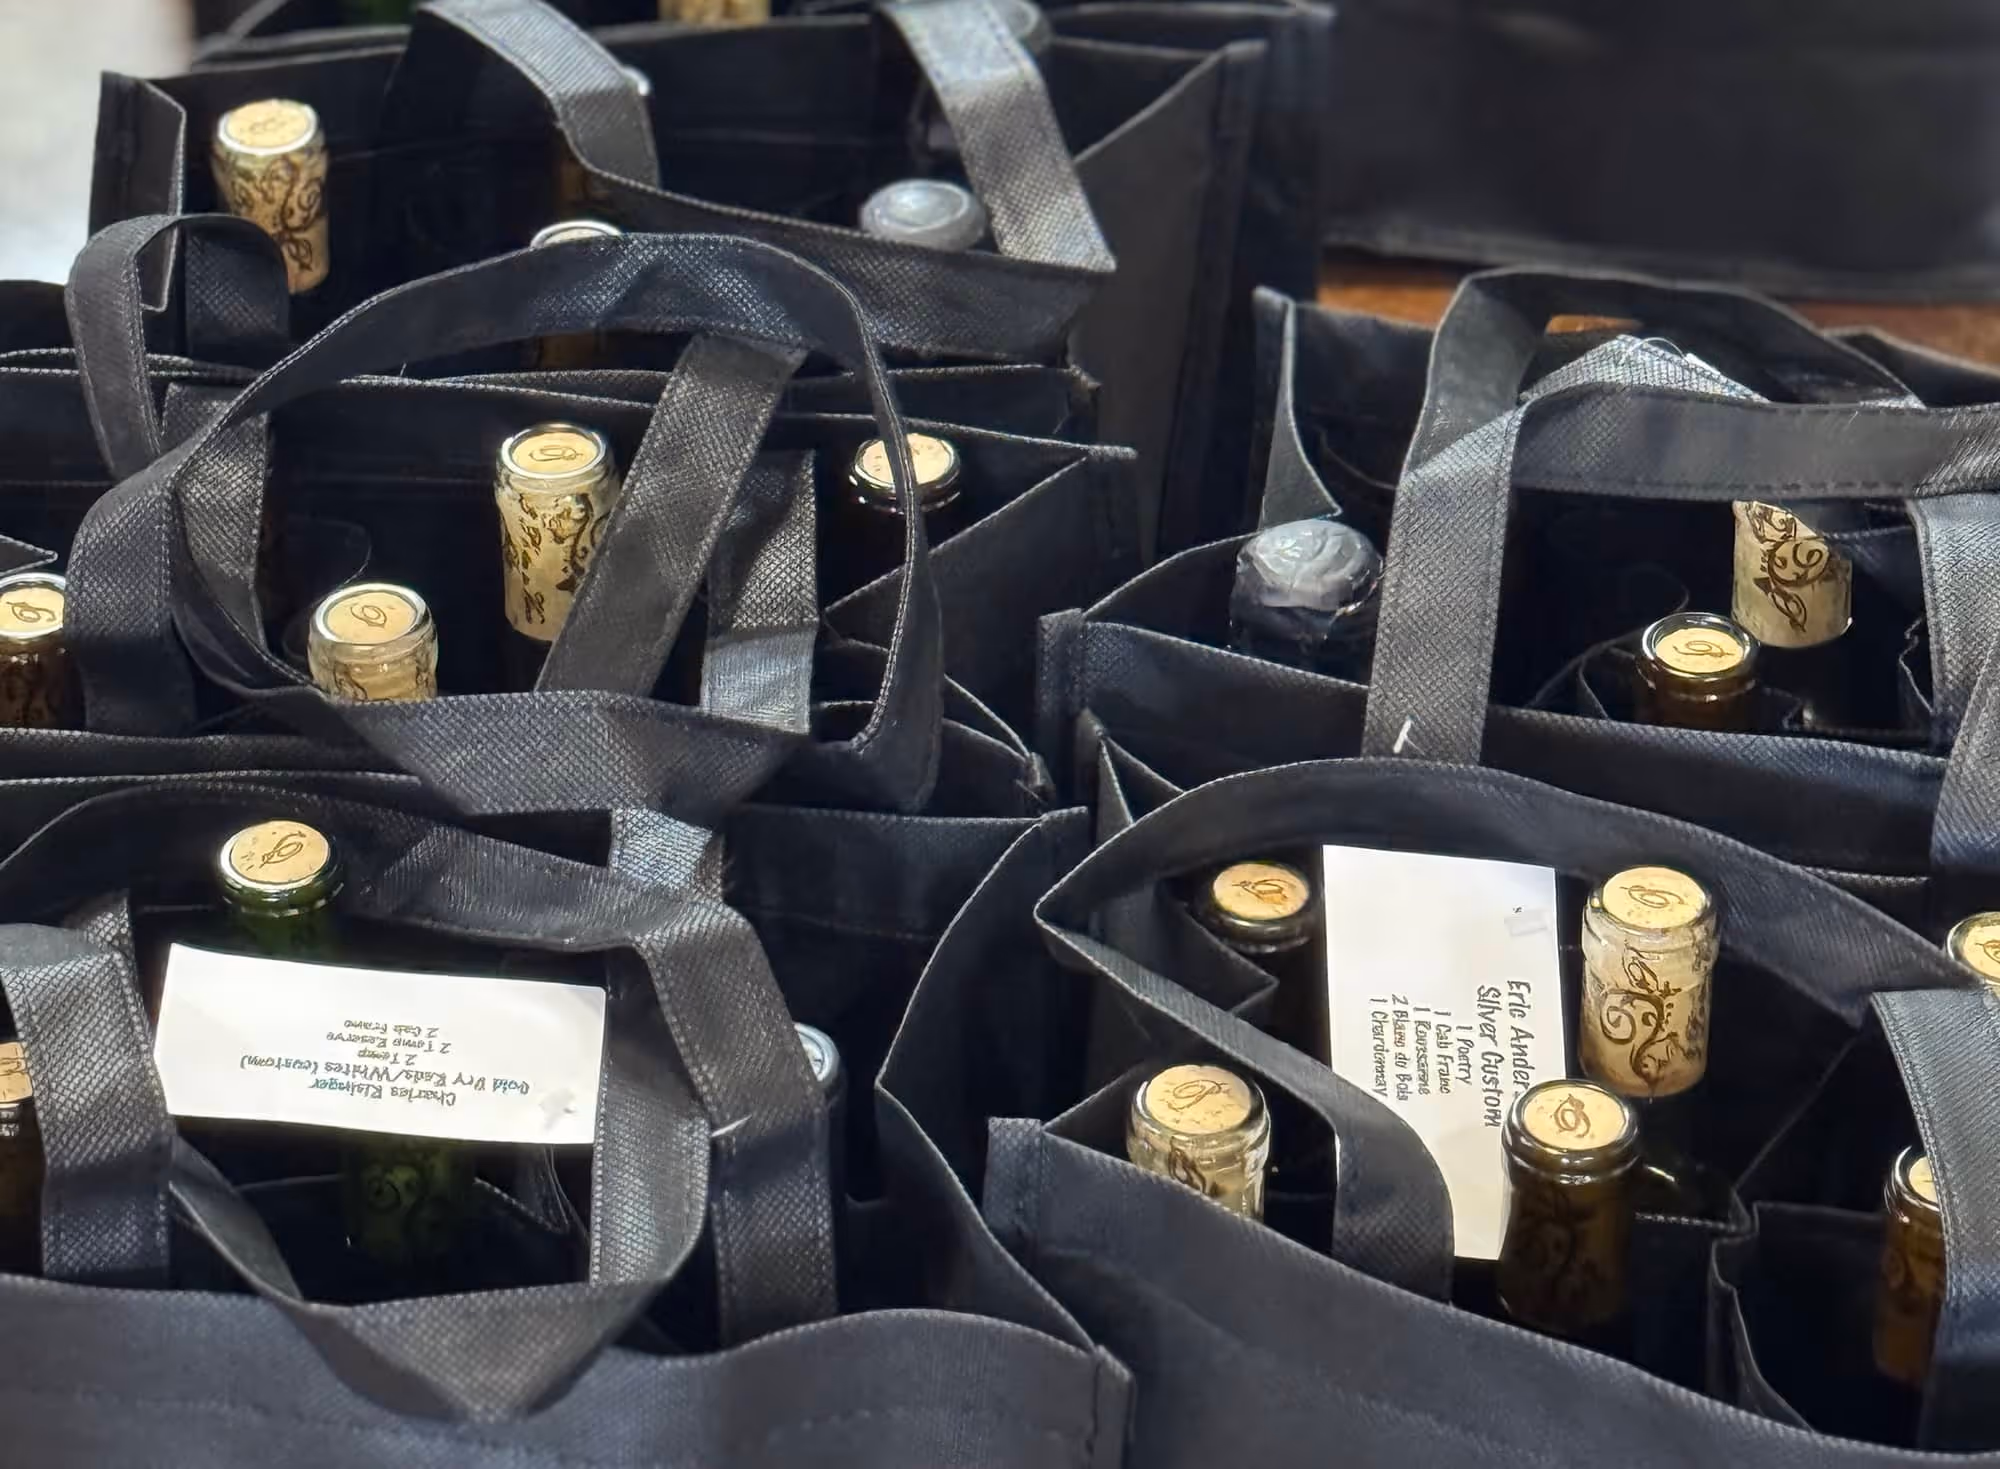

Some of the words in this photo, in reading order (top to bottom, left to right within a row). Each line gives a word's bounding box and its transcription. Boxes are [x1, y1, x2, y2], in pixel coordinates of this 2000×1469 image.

[1392, 994, 1409, 1005] 2
[1507, 980, 1531, 1018] Eric
[1477, 985, 1502, 1047] Silver
[326, 1032, 387, 1048] Reserve
[426, 1027, 439, 1038] 2
[1436, 1024, 1453, 1048] Cab
[439, 1042, 452, 1054] 2
[404, 1054, 417, 1066] 2
[1455, 1038, 1475, 1085] Poetry
[390, 1086, 456, 1106] Charles
[1481, 1051, 1505, 1127] Custom
